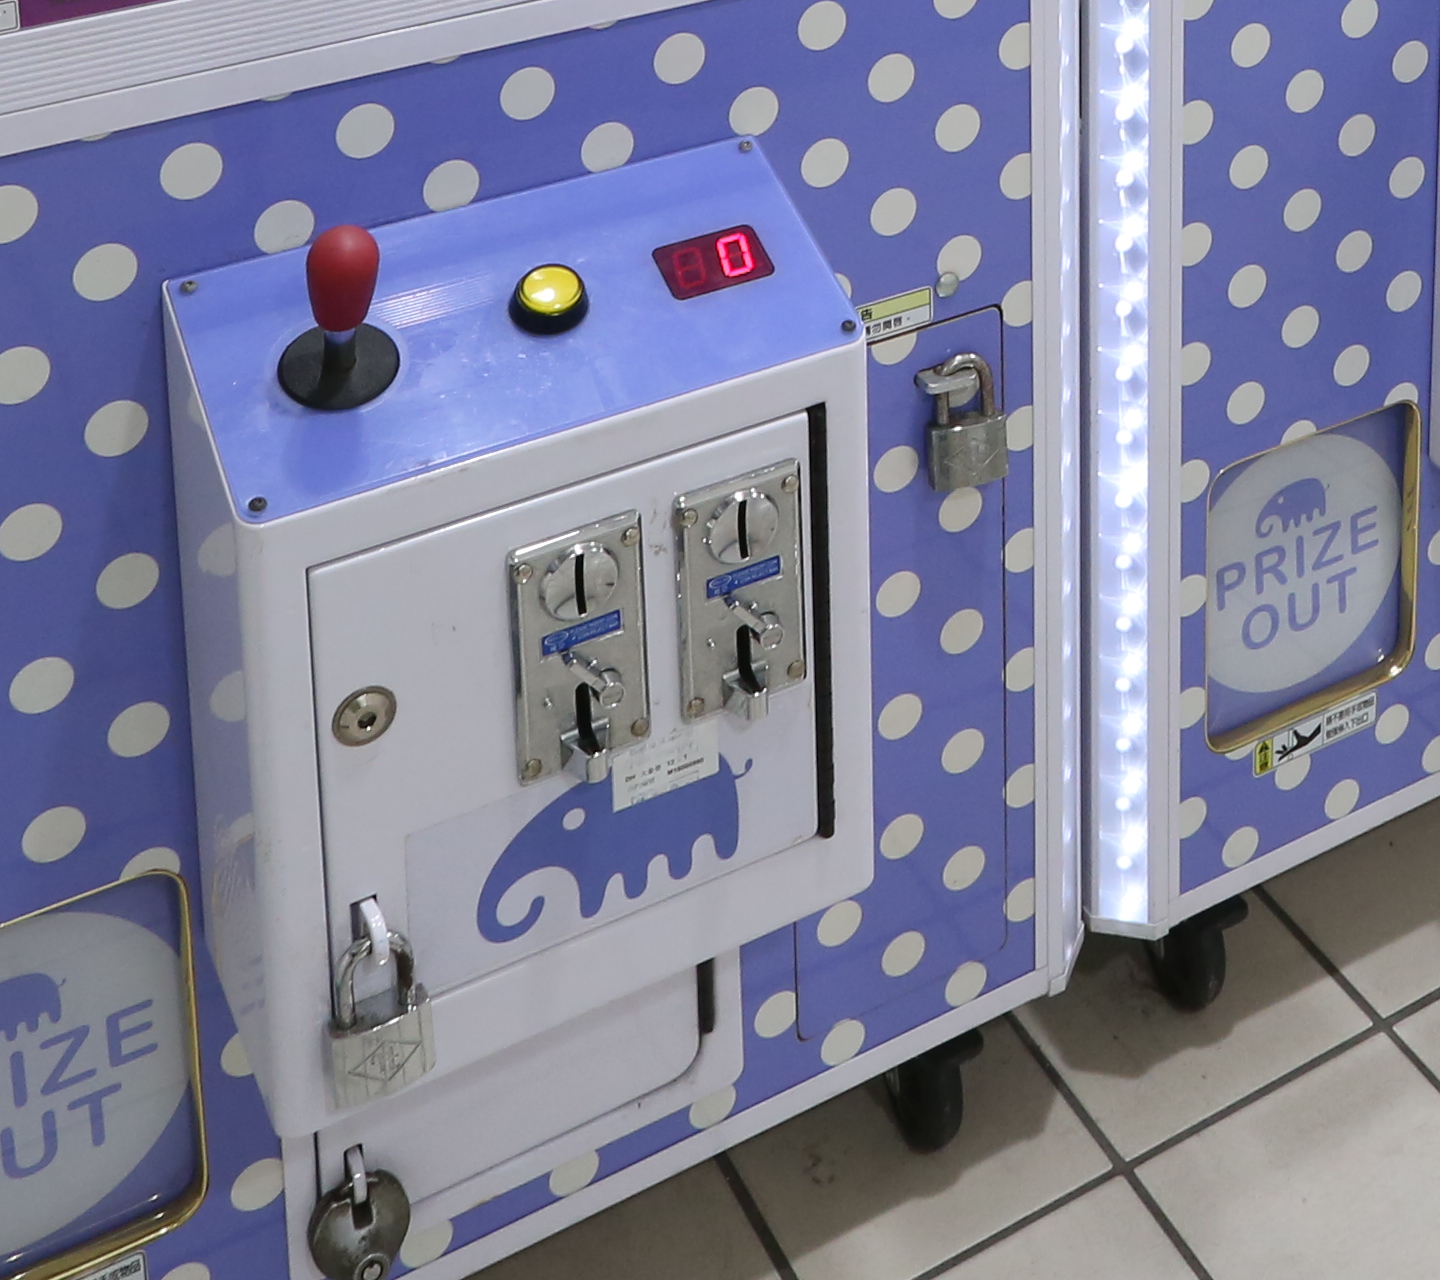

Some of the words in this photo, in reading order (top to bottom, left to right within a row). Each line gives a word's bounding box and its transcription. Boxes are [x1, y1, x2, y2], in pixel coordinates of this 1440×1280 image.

[716, 232, 755, 278] 0
[1215, 504, 1380, 611] PRIZE
[1241, 566, 1357, 650] OUT
